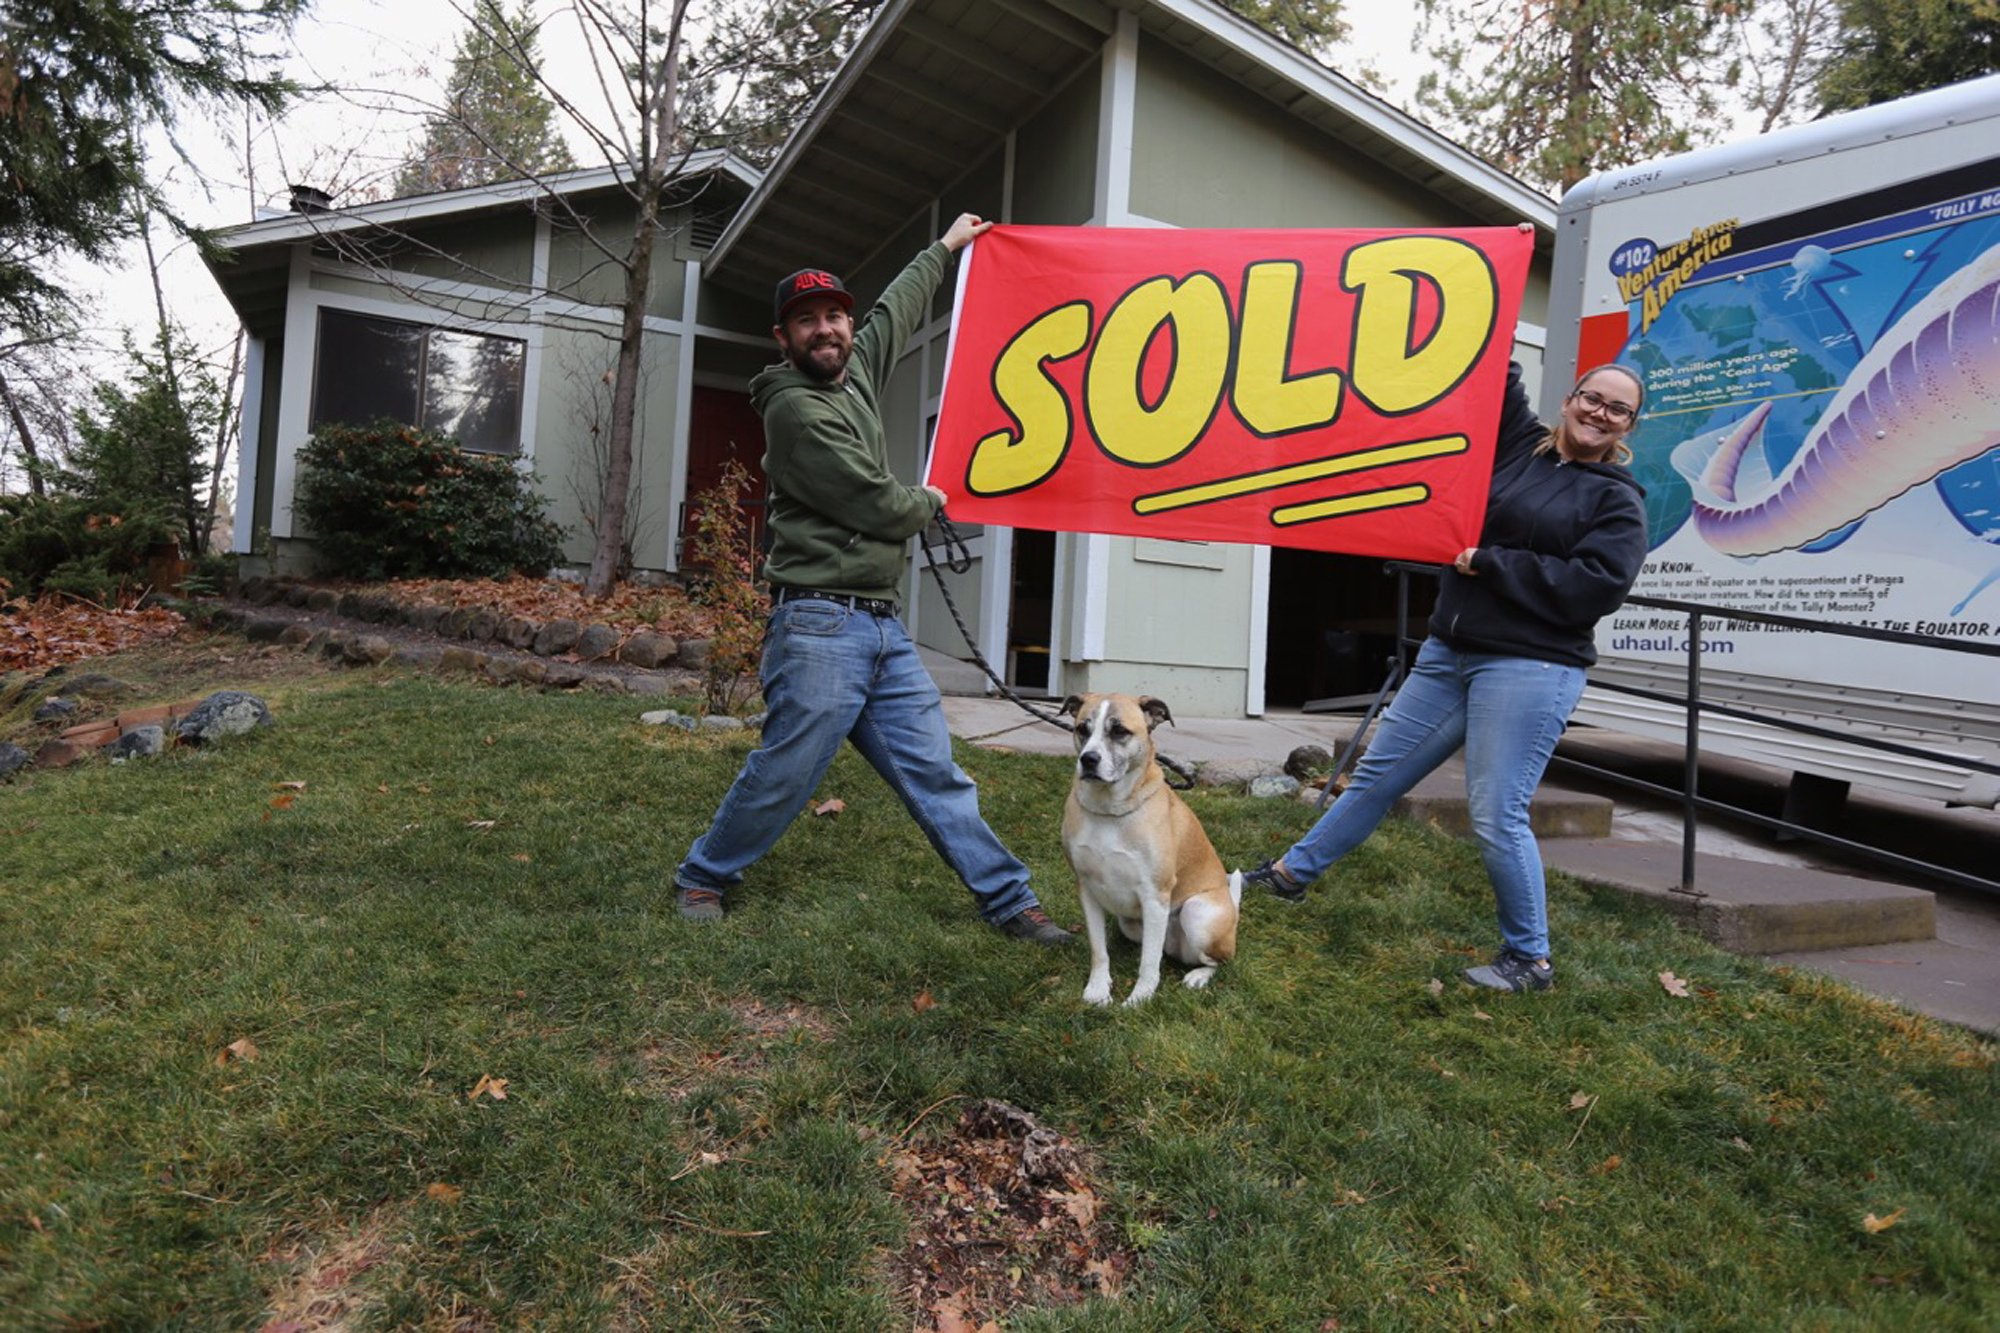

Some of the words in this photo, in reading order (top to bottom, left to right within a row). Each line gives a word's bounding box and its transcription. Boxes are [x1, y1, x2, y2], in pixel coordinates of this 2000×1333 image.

[1614, 245, 1651, 270] #102
[1617, 249, 1690, 305] Venture
[1691, 217, 1742, 247] Across
[1641, 233, 1733, 337] America
[965, 235, 1499, 499] SOLD
[1648, 376, 1692, 391] during
[1694, 373, 1716, 383] the
[1719, 364, 1756, 378] "Coal
[1761, 357, 1798, 372] Age"
[1649, 368, 1675, 379] 300
[1677, 360, 1721, 374] million
[1725, 352, 1764, 368] years
[1769, 347, 1799, 358] ago
[1641, 562, 1657, 574] OU
[1661, 578, 1673, 589] lay
[1676, 579, 1693, 587] near
[1696, 577, 1709, 587] the
[1711, 578, 1744, 588] equator
[1747, 578, 1757, 586] on
[1760, 577, 1775, 586] the
[1779, 575, 1847, 588] supercontinent
[1850, 574, 1862, 585] of
[1865, 574, 1904, 586] Pangea
[1669, 591, 1678, 599] to
[1681, 592, 1707, 601] unique
[1710, 590, 1751, 599] creatures.
[1754, 589, 1774, 599] How
[1778, 588, 1791, 598] did
[1795, 588, 1810, 598] the
[1814, 589, 1836, 601] strip
[1839, 588, 1874, 600] mining
[1877, 588, 1890, 599] of
[1741, 603, 1766, 611] secret
[1769, 601, 1780, 611] of
[1782, 602, 1797, 611] the
[1827, 601, 1875, 612] Monster?
[1613, 618, 1646, 631] LEARN
[1648, 618, 1680, 631] MORE
[1683, 618, 1723, 632] AOUT
[1726, 618, 1760, 632] WHEN
[1915, 620, 1989, 637] EQUATOR
